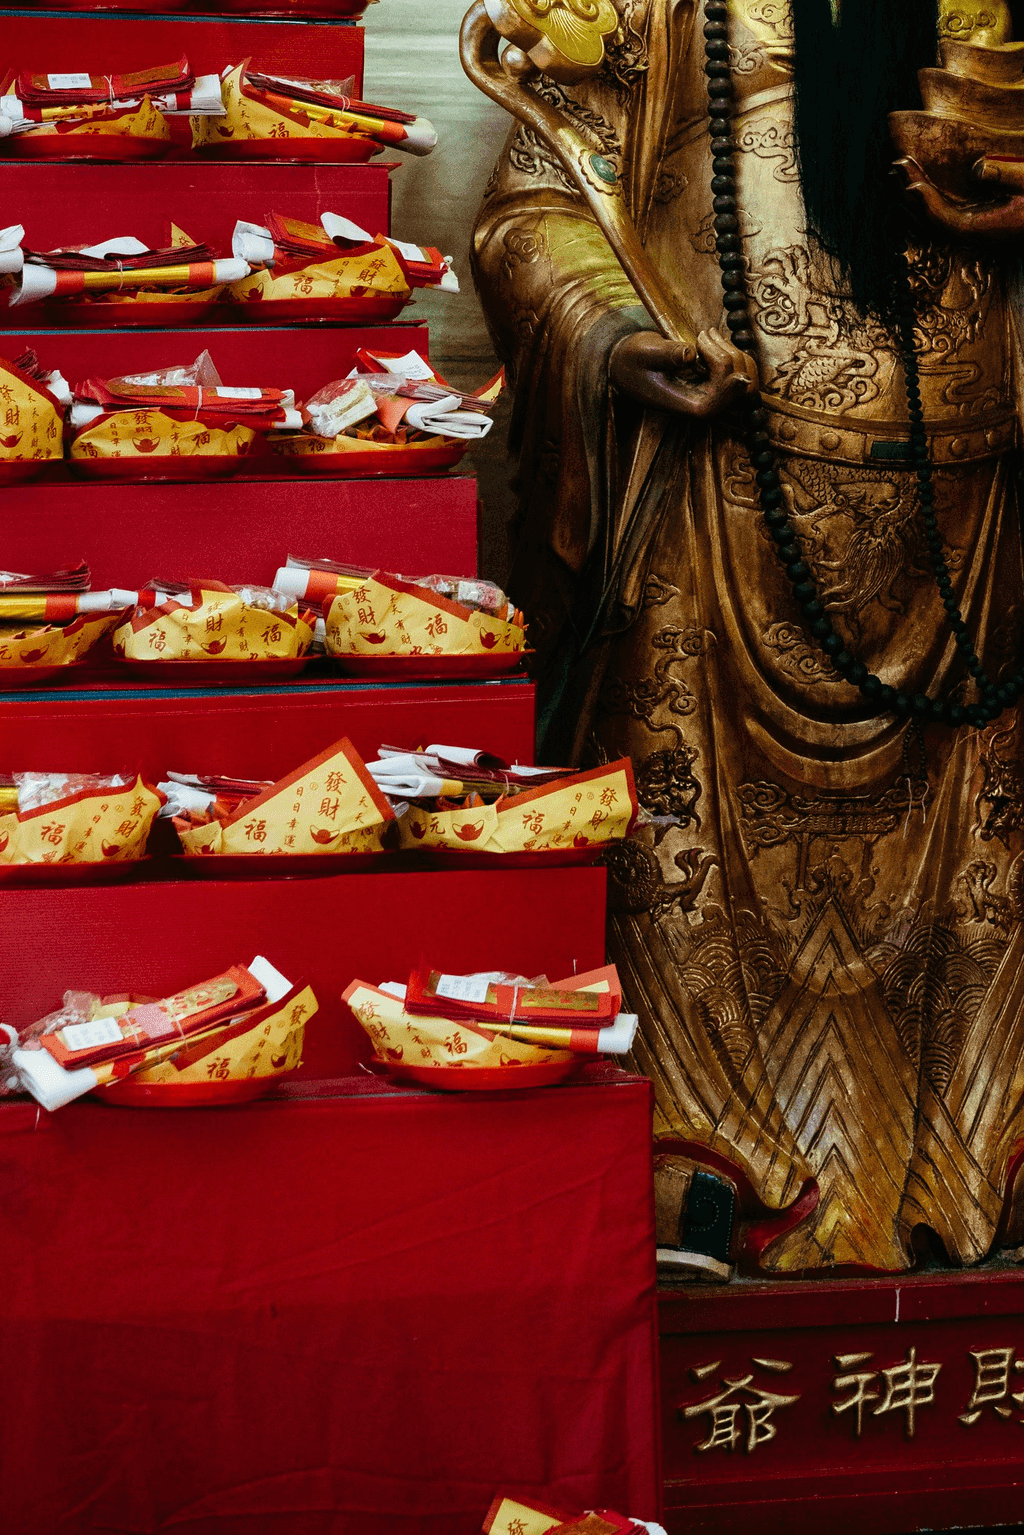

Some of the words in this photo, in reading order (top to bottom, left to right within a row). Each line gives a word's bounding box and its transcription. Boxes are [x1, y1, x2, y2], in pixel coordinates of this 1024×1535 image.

[294, 273, 314, 294] 福
[356, 257, 387, 285] 發財
[352, 585, 375, 627] 發財
[149, 627, 167, 651] 福
[261, 622, 281, 645] 福
[424, 613, 448, 639] 福
[317, 770, 348, 821] 發財
[588, 786, 619, 830] 發財
[115, 797, 147, 839] 發財
[244, 817, 267, 843] 福
[284, 786, 304, 848] 日日幸運
[429, 815, 446, 835] 元
[522, 809, 545, 835] 福
[41, 820, 66, 844] 福
[445, 1031, 468, 1054] 福
[207, 1057, 230, 1079] 福
